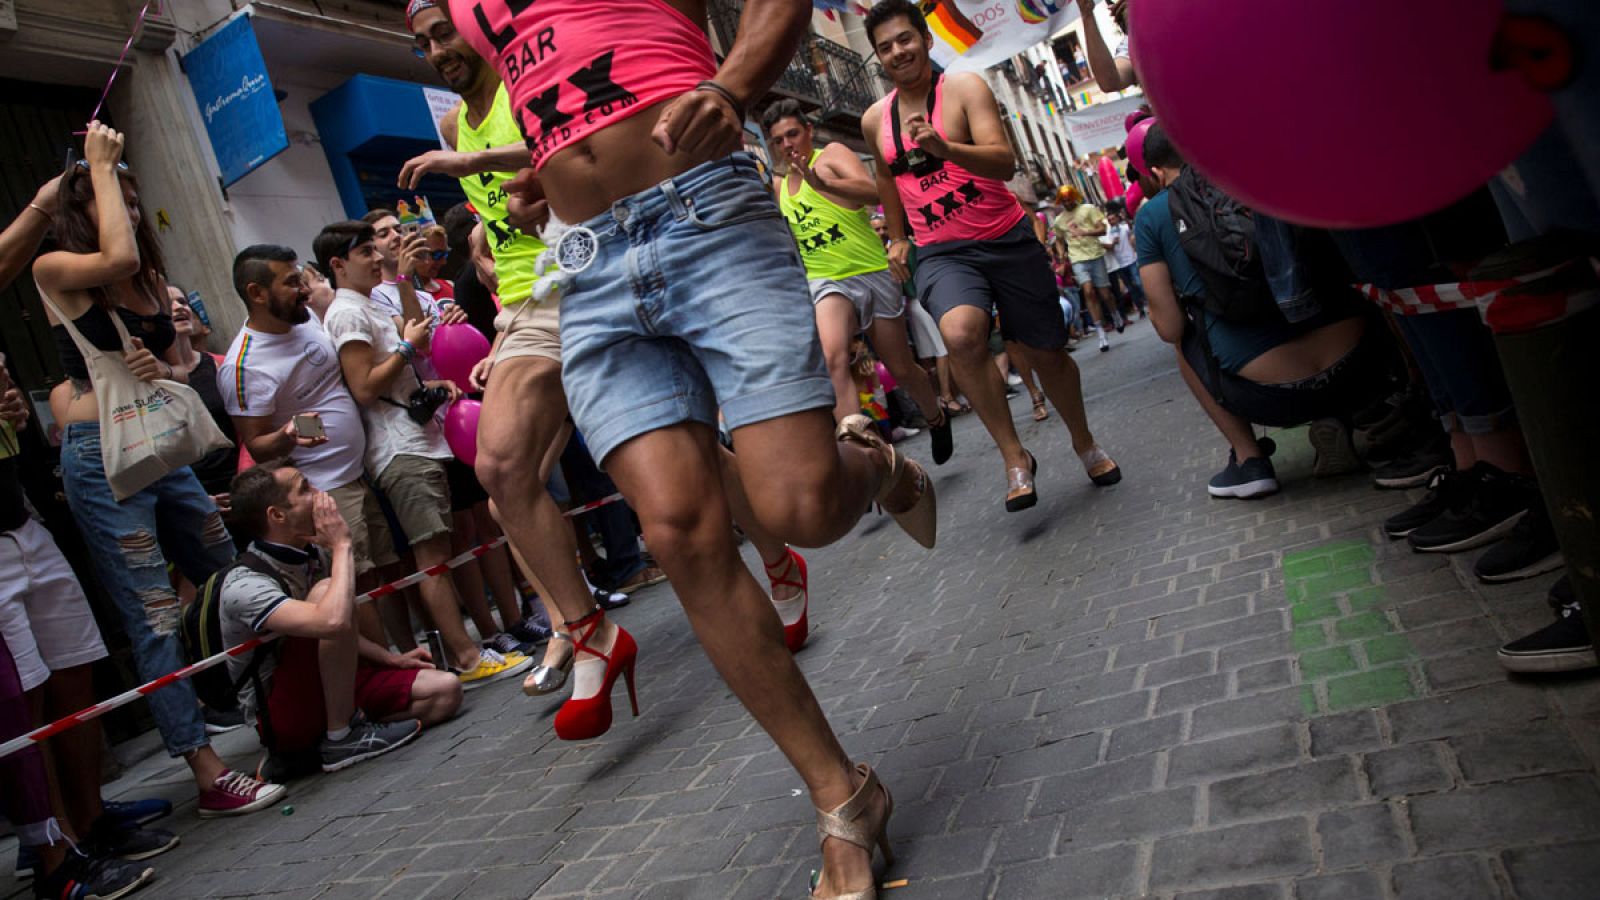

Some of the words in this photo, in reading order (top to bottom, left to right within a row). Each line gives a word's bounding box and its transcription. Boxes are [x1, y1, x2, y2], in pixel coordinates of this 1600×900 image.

[505, 26, 556, 85] BAR
[920, 171, 950, 192] BAR
[487, 186, 509, 208] BA
[917, 179, 982, 227] XXX
[794, 201, 813, 223] LL
[800, 217, 820, 232] BAR
